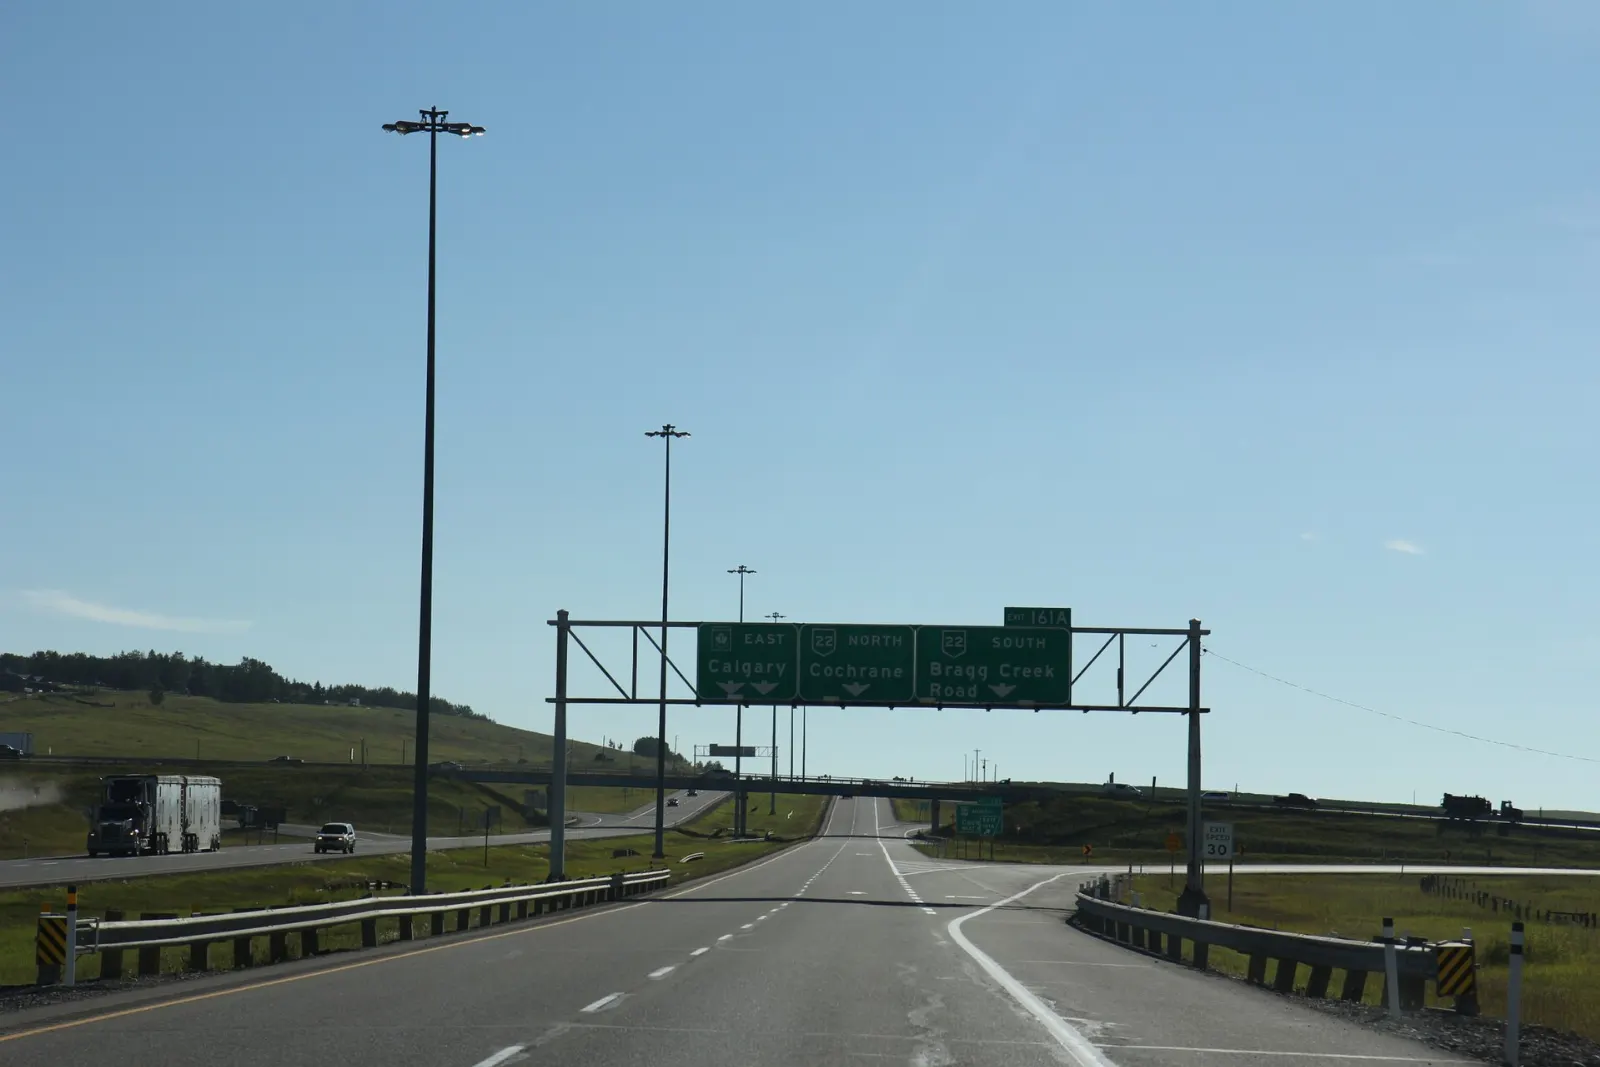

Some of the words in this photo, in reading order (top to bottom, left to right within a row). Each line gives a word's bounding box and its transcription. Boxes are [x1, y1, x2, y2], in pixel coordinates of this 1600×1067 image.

[1007, 613, 1025, 621] EXIT
[1031, 610, 1067, 625] 161A
[744, 633, 785, 645] EAST
[815, 635, 833, 647] 22
[848, 635, 902, 647] NORTH
[945, 636, 964, 647] 22
[991, 636, 1046, 649] SOUTH
[708, 659, 787, 678] Calgary
[809, 662, 903, 678] Cochrane
[929, 662, 988, 681] Bragg
[999, 663, 1055, 678] Creek
[929, 683, 977, 698] Road
[1207, 843, 1227, 856] 30
